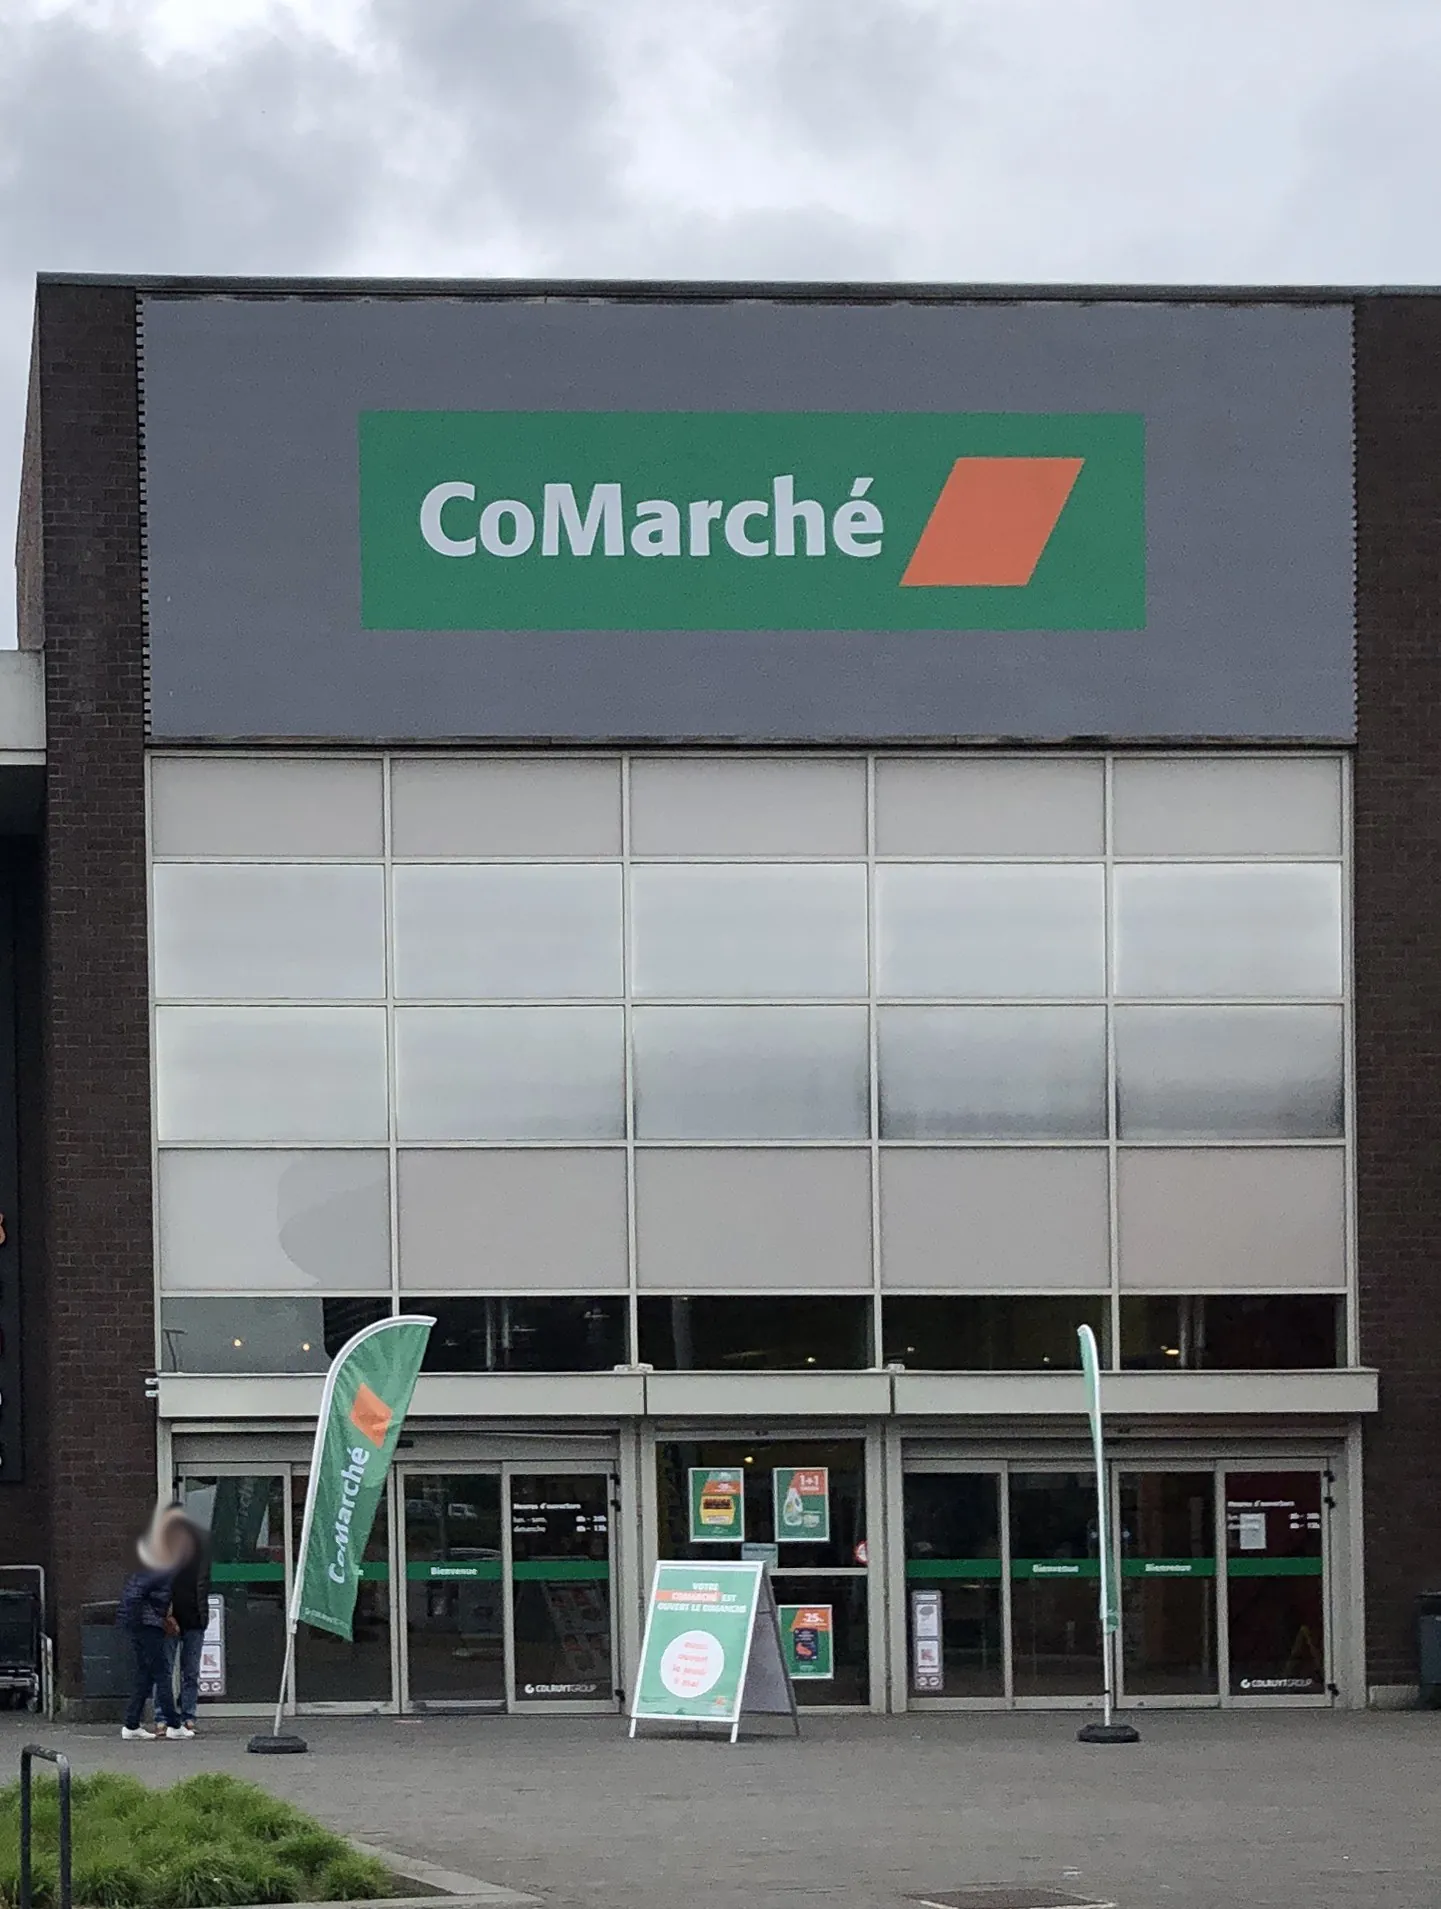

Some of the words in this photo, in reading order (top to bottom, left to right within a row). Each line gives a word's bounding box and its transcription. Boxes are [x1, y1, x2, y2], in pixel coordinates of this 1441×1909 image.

[419, 474, 884, 558] CoMarché
[328, 1446, 370, 1584] CoMarché
[430, 1566, 478, 1576] Bienvenue
